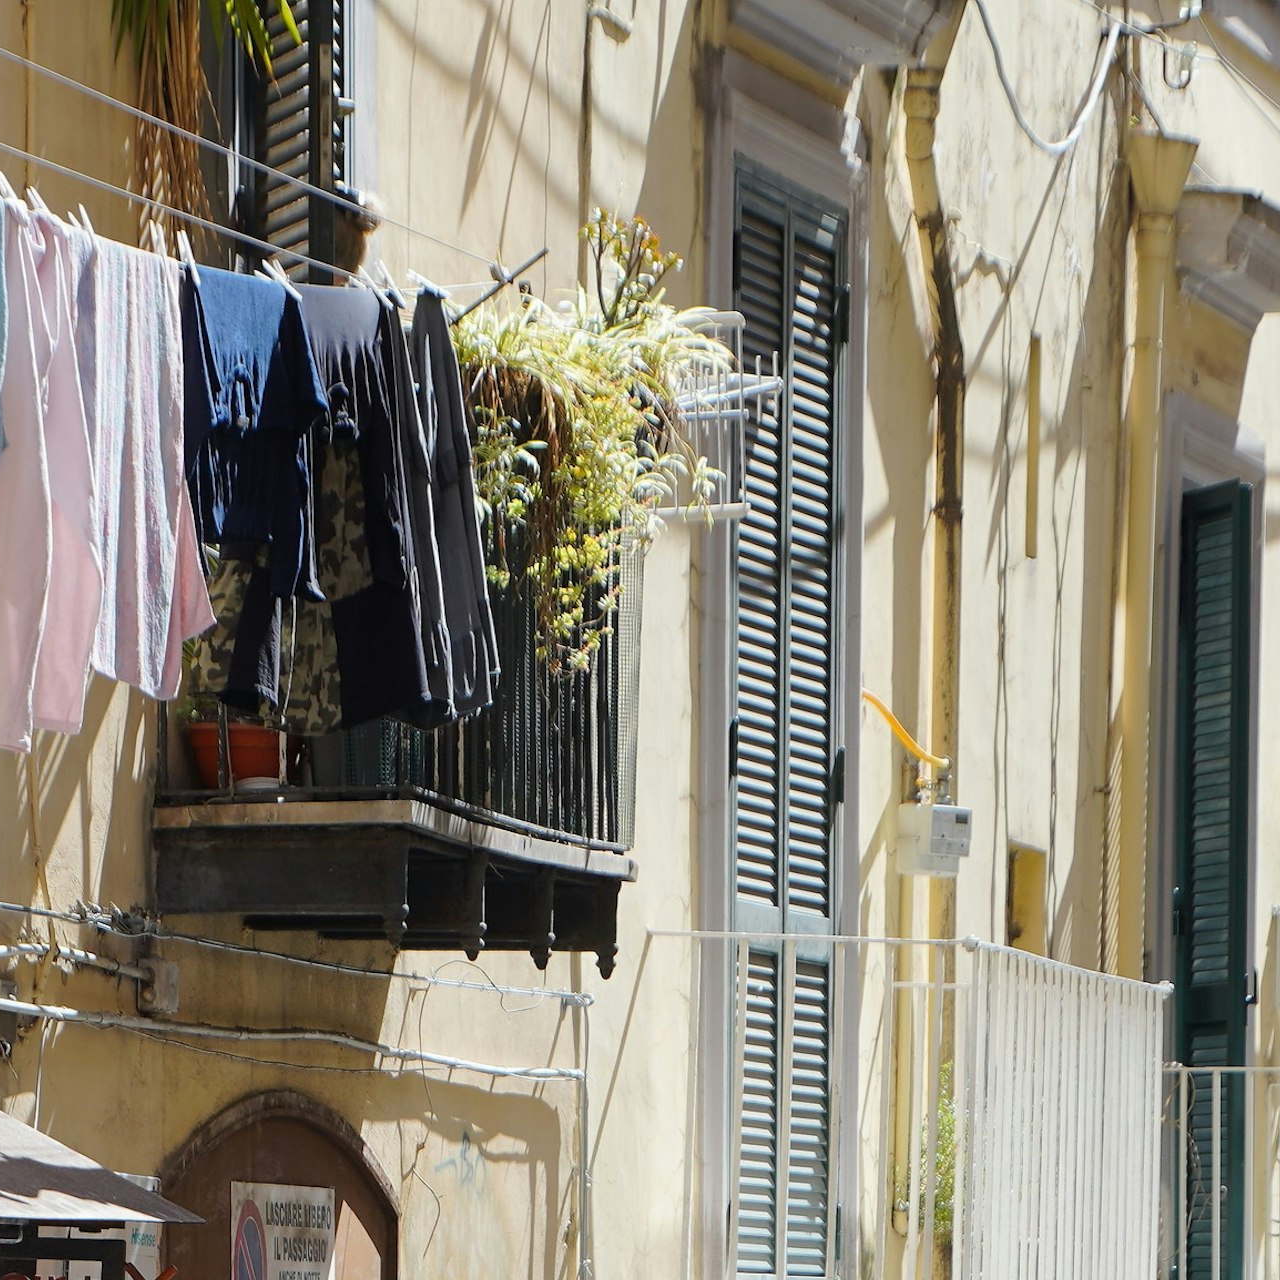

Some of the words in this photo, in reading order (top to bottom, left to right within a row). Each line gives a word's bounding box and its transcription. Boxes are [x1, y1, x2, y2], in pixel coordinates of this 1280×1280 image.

[266, 1201, 303, 1227] LASCIARE
[304, 1203, 332, 1230] LIBERO
[131, 1227, 157, 1247] Hisense
[273, 1238, 282, 1262] IL
[283, 1238, 328, 1264] PASSAGGIO
